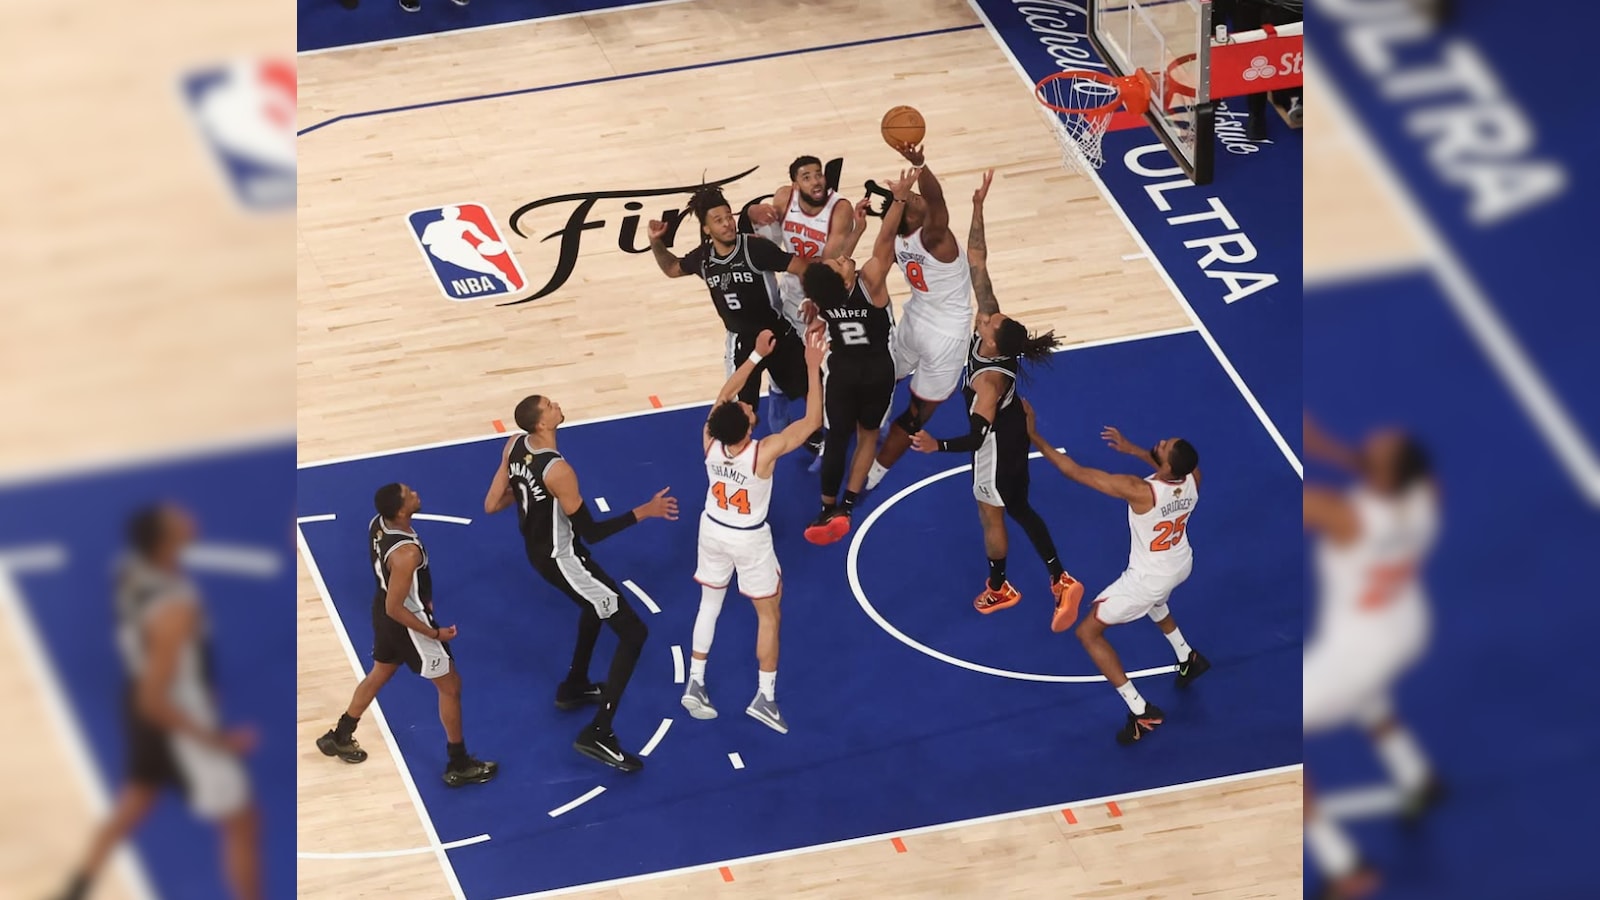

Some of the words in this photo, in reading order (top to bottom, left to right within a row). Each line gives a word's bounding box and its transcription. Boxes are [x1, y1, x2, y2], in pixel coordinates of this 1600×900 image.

[1278, 51, 1303, 76] St
[1123, 143, 1279, 304] ULTRA
[790, 236, 819, 258] 32
[451, 275, 496, 296] NBA
[906, 260, 929, 293] 8
[724, 292, 742, 310] 5
[825, 307, 868, 319] HARPER
[838, 321, 870, 345] 2
[711, 464, 748, 485] SHAMET
[711, 480, 751, 515] 44
[1149, 511, 1190, 552] 25
